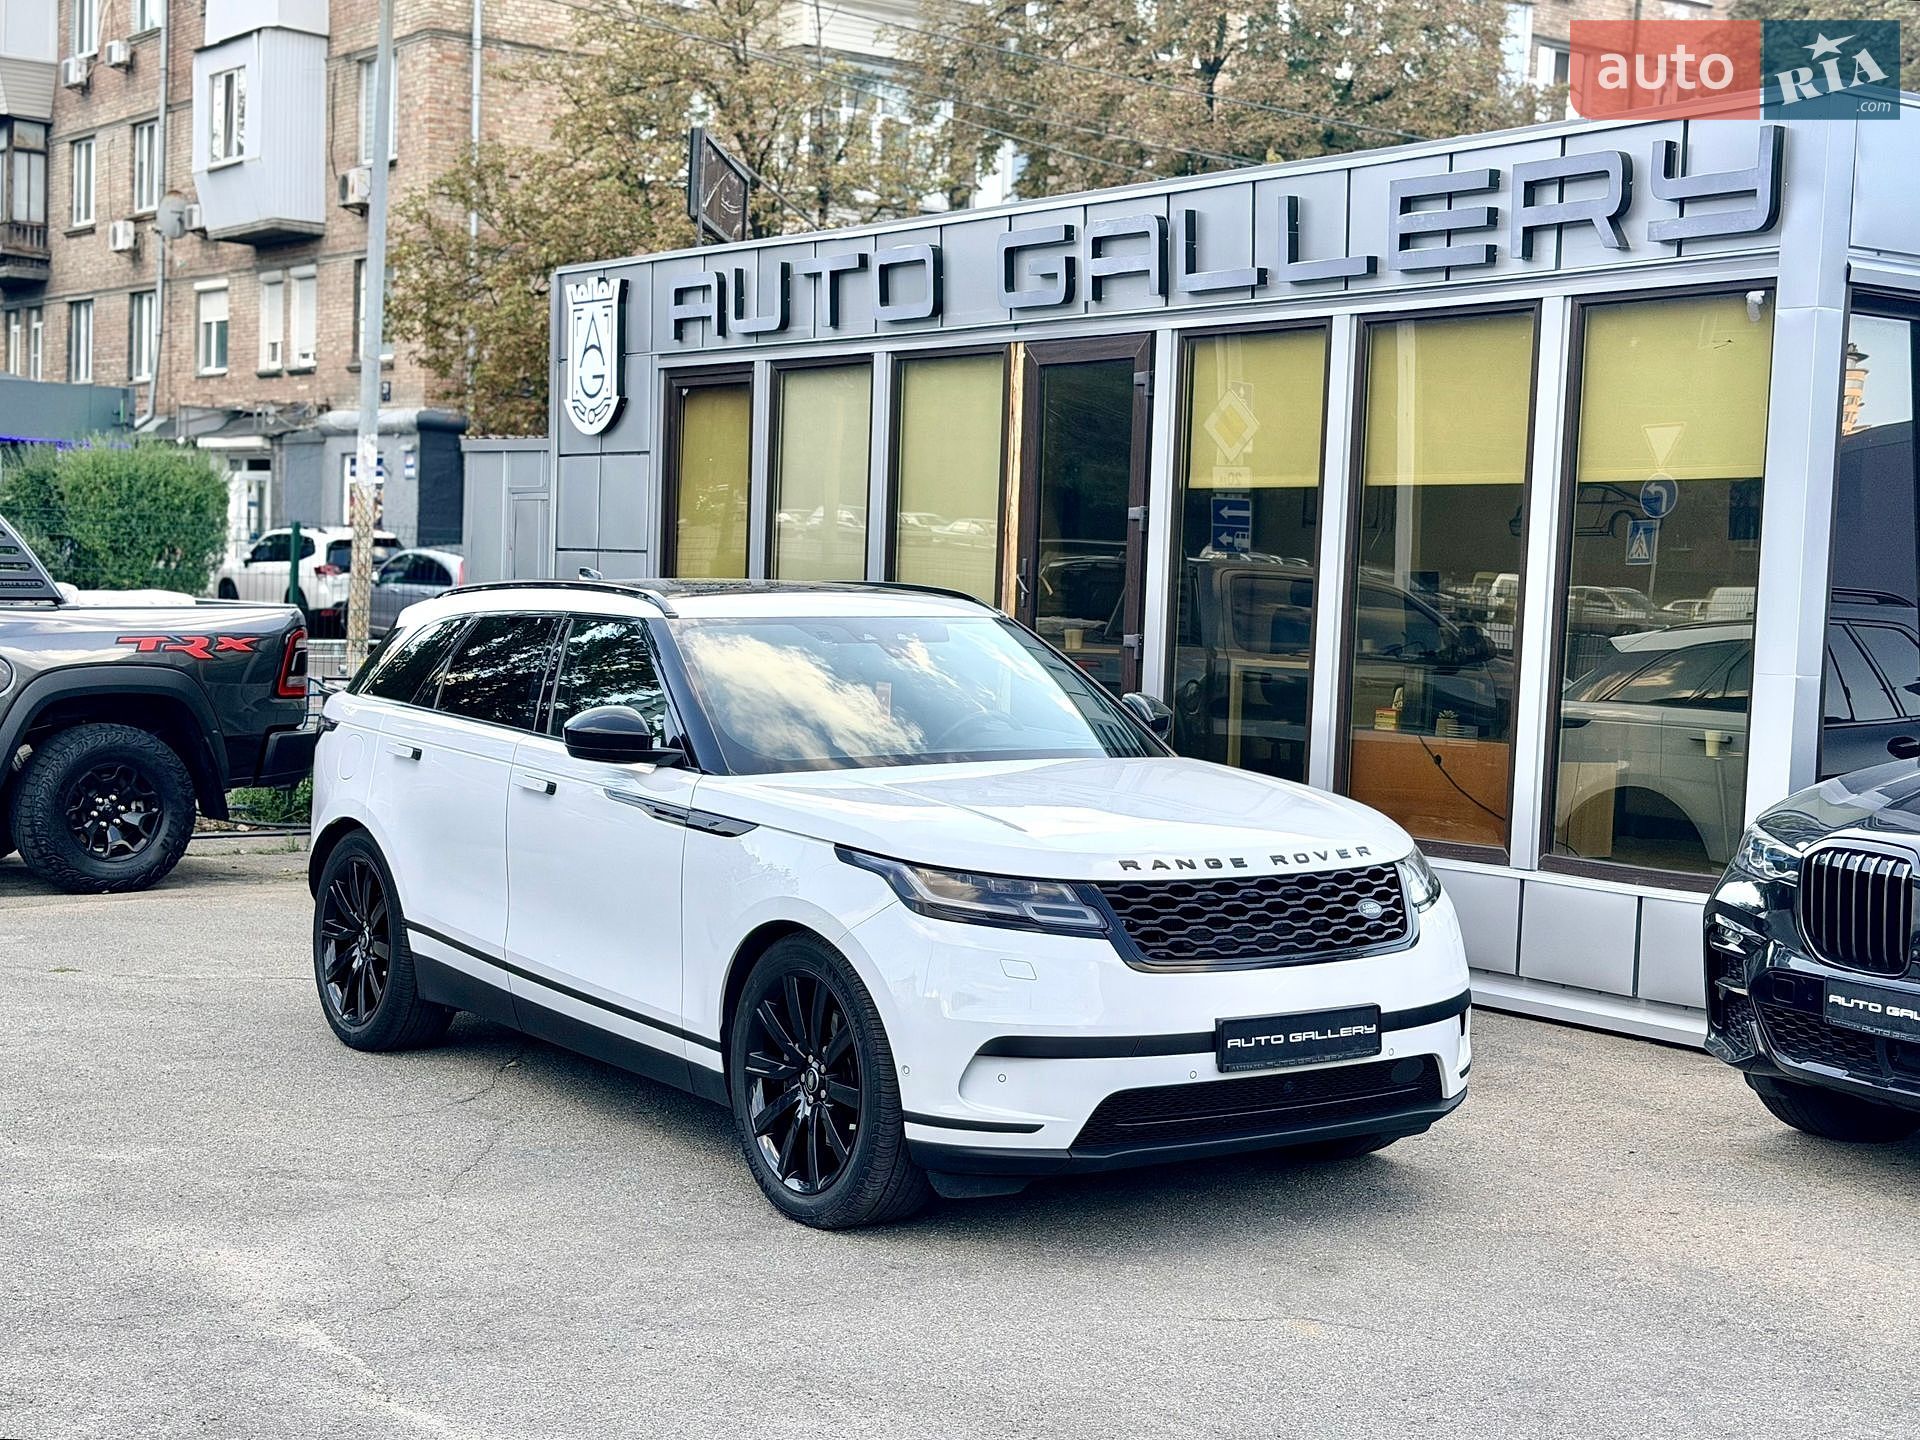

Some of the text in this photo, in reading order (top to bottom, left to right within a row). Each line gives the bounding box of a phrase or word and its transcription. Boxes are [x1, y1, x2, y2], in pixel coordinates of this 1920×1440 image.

[669, 124, 1787, 342] AUTO GALLERY
[116, 635, 262, 660] TRX
[1118, 846, 1373, 871] RANGE ROVER
[1827, 994, 1882, 1013] AUTO
[1227, 1024, 1377, 1049] AUTO GALLERY
